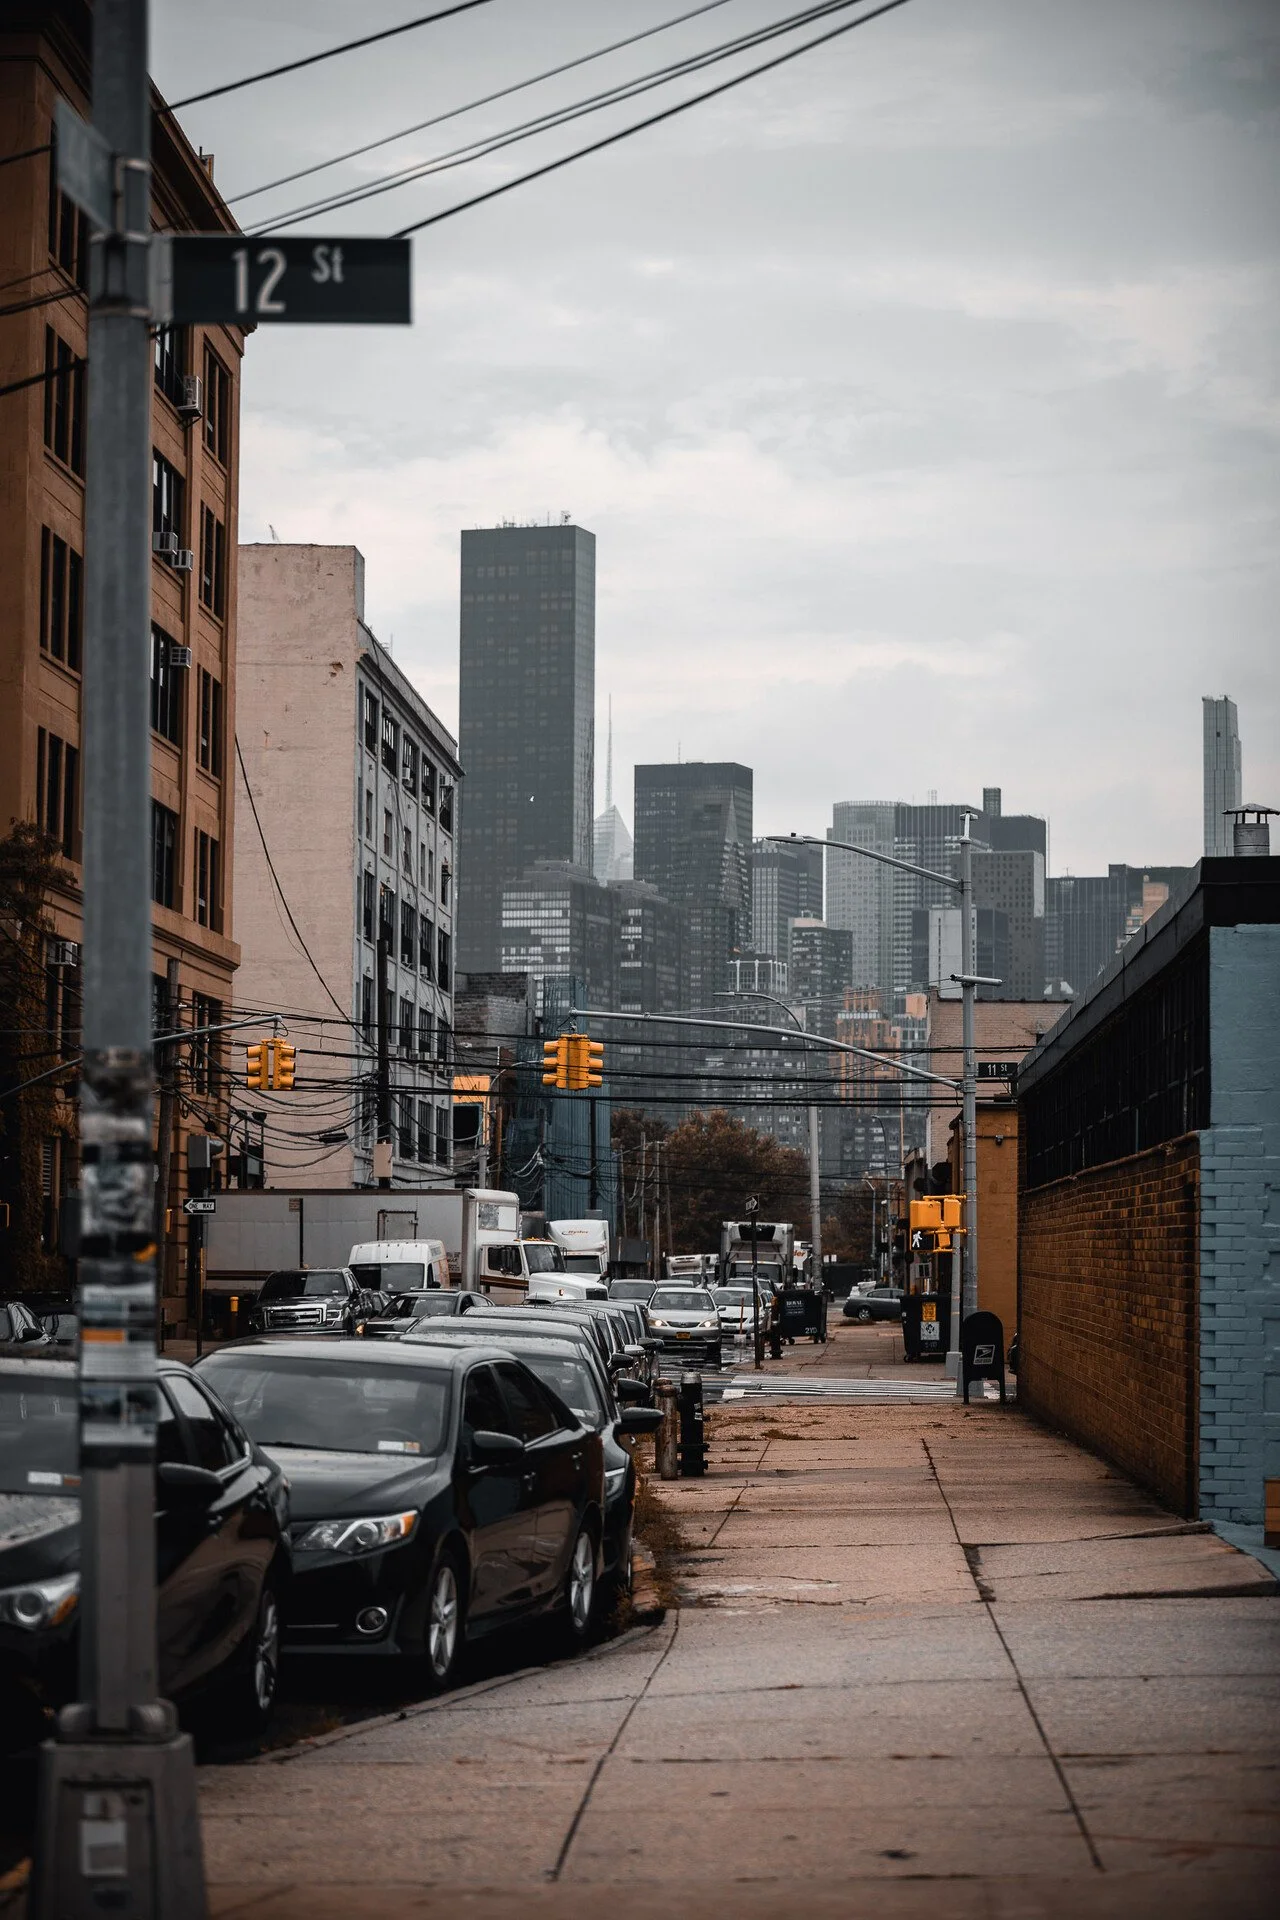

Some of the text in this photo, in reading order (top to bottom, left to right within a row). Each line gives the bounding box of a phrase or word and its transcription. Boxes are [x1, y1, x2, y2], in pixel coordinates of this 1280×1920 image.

[232, 245, 345, 314] 12 St
[988, 1064, 996, 1075] 11
